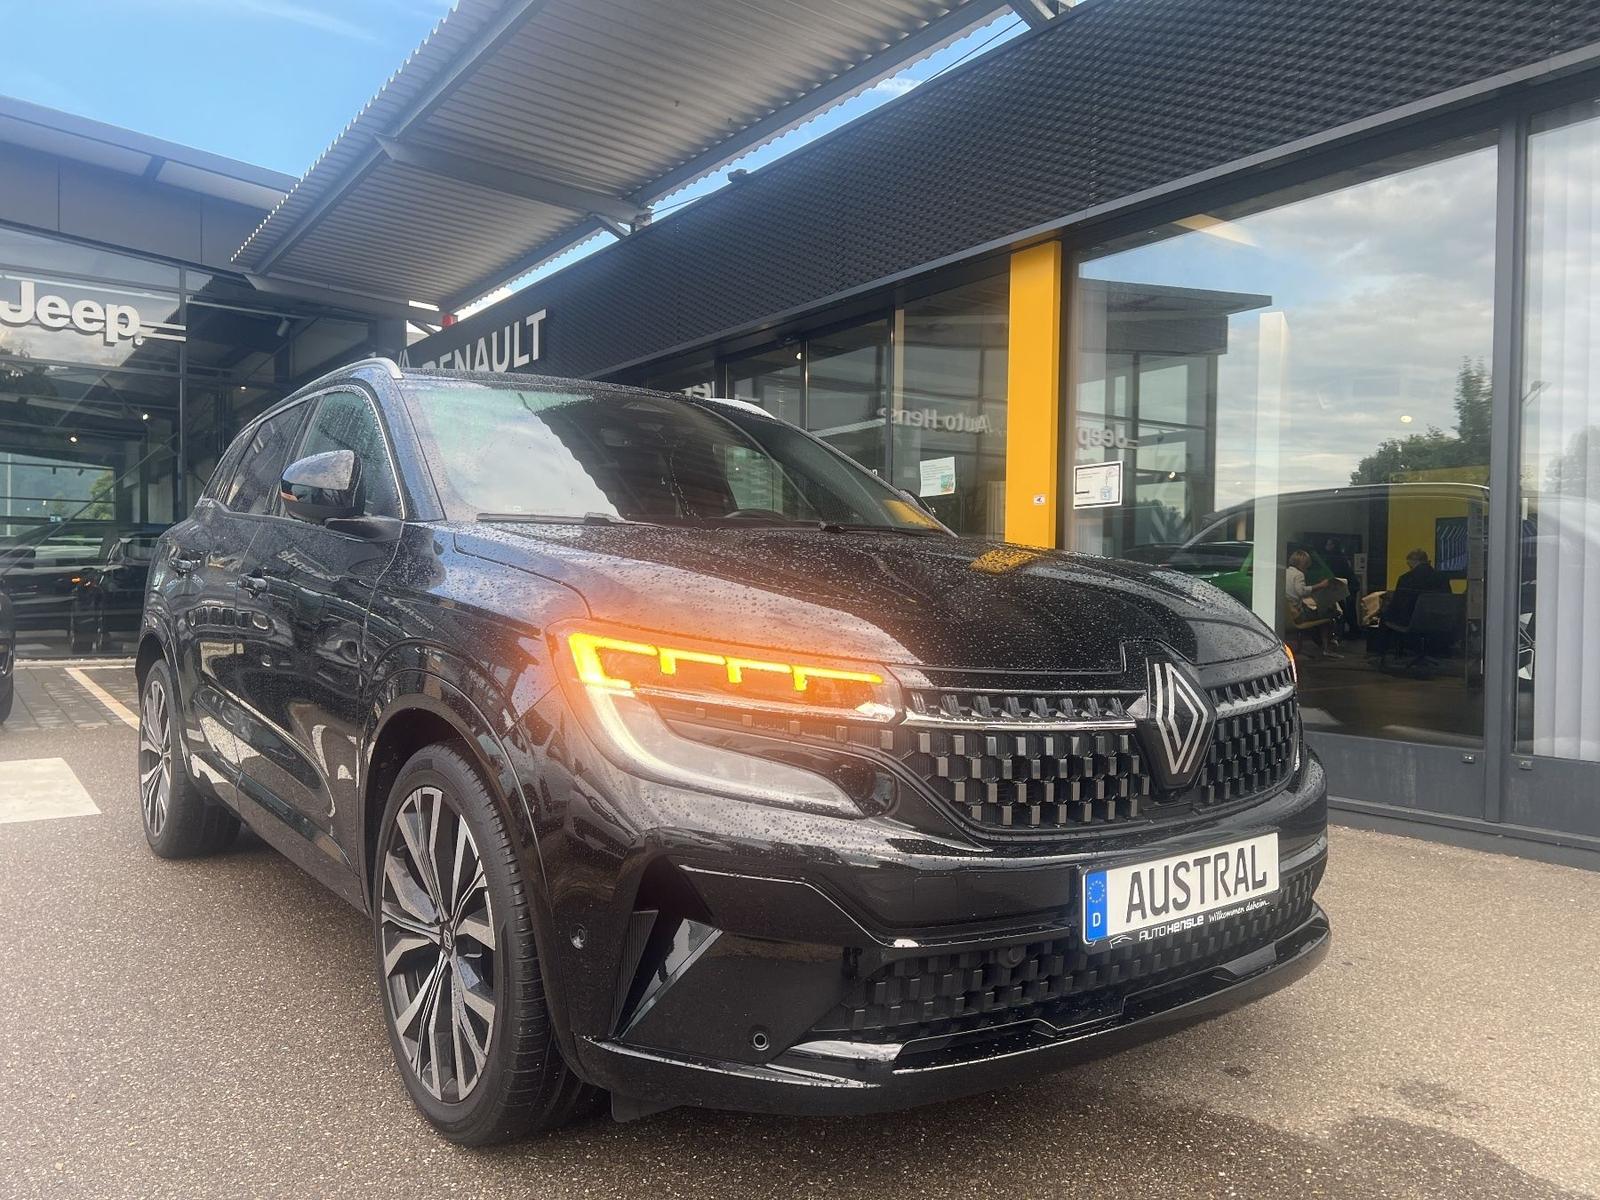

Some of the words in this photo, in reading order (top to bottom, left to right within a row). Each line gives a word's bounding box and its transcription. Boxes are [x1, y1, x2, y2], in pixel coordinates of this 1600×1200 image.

[0, 280, 140, 343] Jeep
[421, 308, 547, 374] NAULT
[1125, 844, 1268, 924] AUSTRAL
[1092, 912, 1101, 928] D
